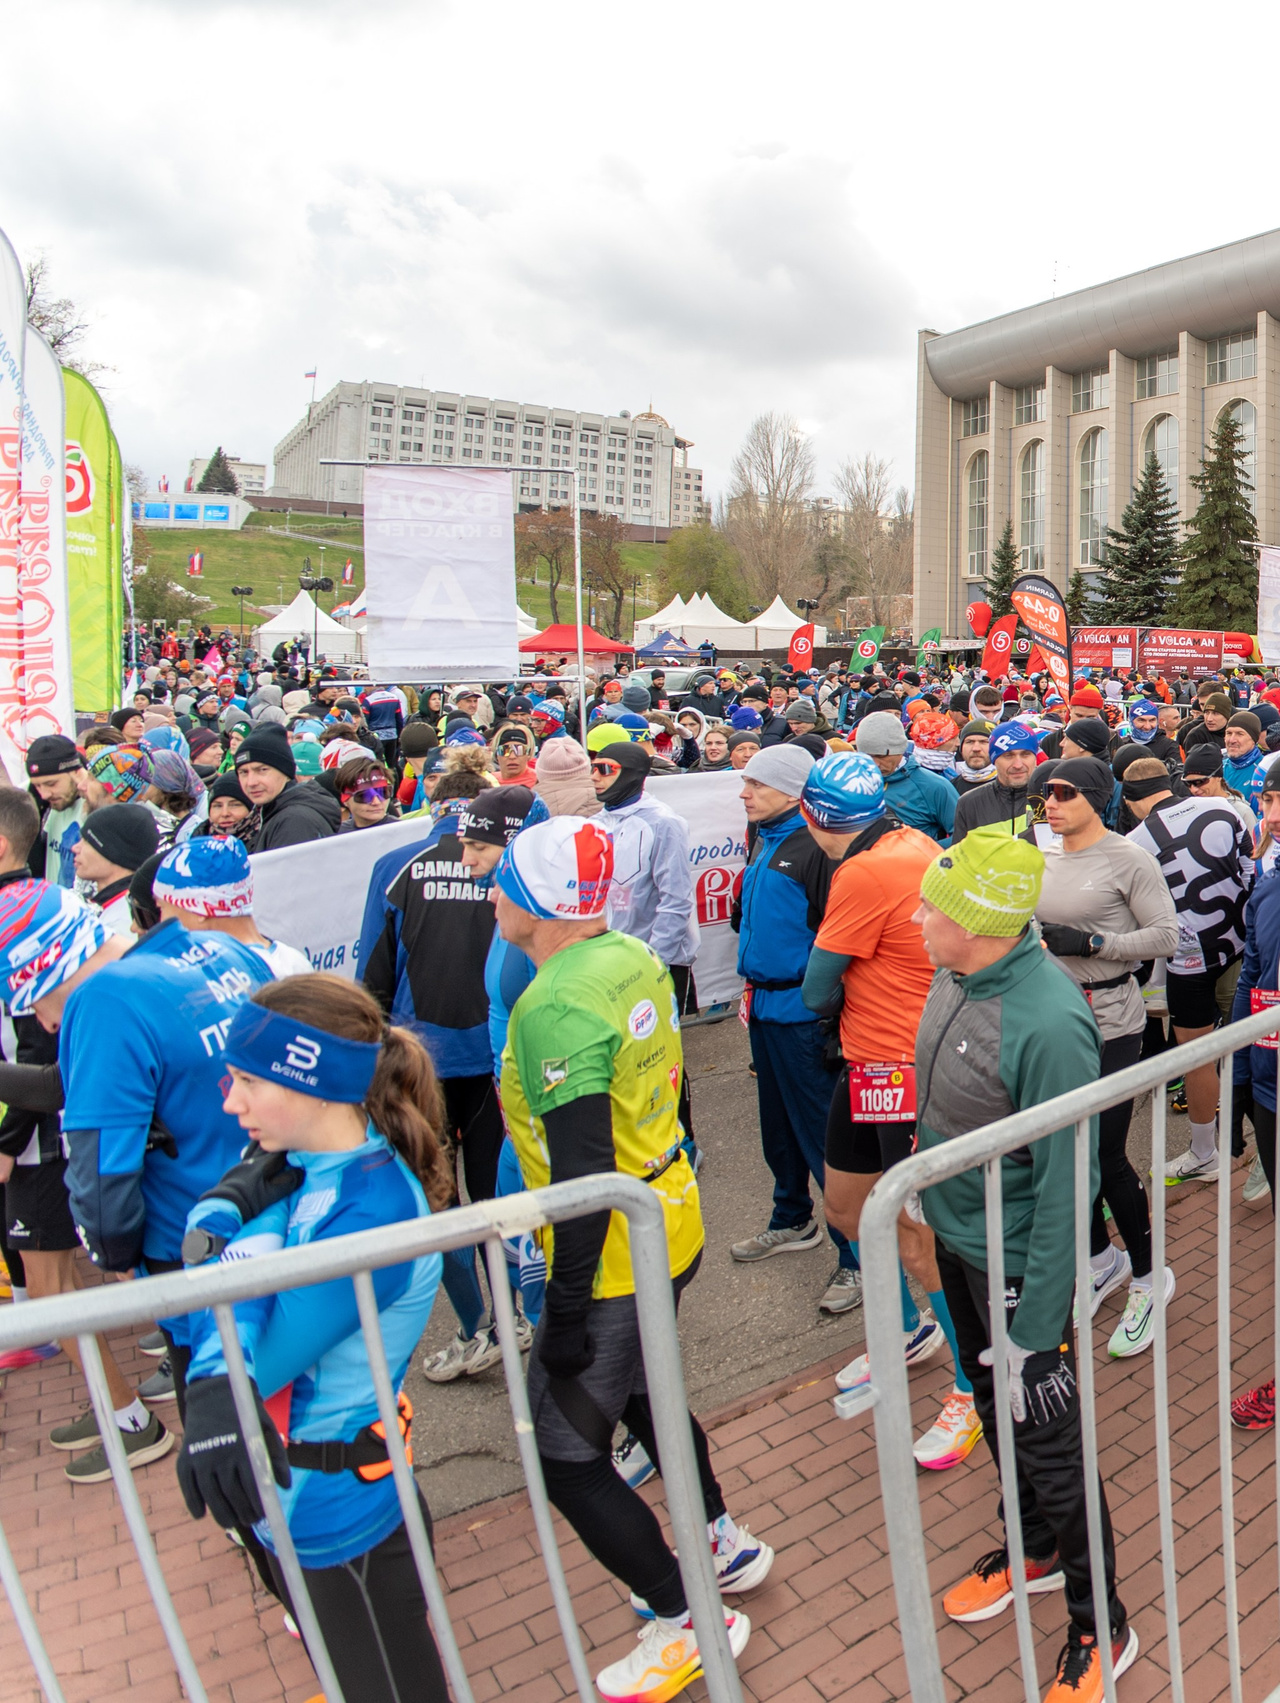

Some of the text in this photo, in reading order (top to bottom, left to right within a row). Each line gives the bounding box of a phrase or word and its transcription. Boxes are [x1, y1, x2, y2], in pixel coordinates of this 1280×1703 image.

[1084, 634, 1130, 644] VOLGAMAN
[1158, 635, 1215, 648] VOLGAMAN
[541, 706, 561, 718] RUN
[860, 1087, 905, 1112] 11087
[188, 1432, 238, 1455] MADSHUS
